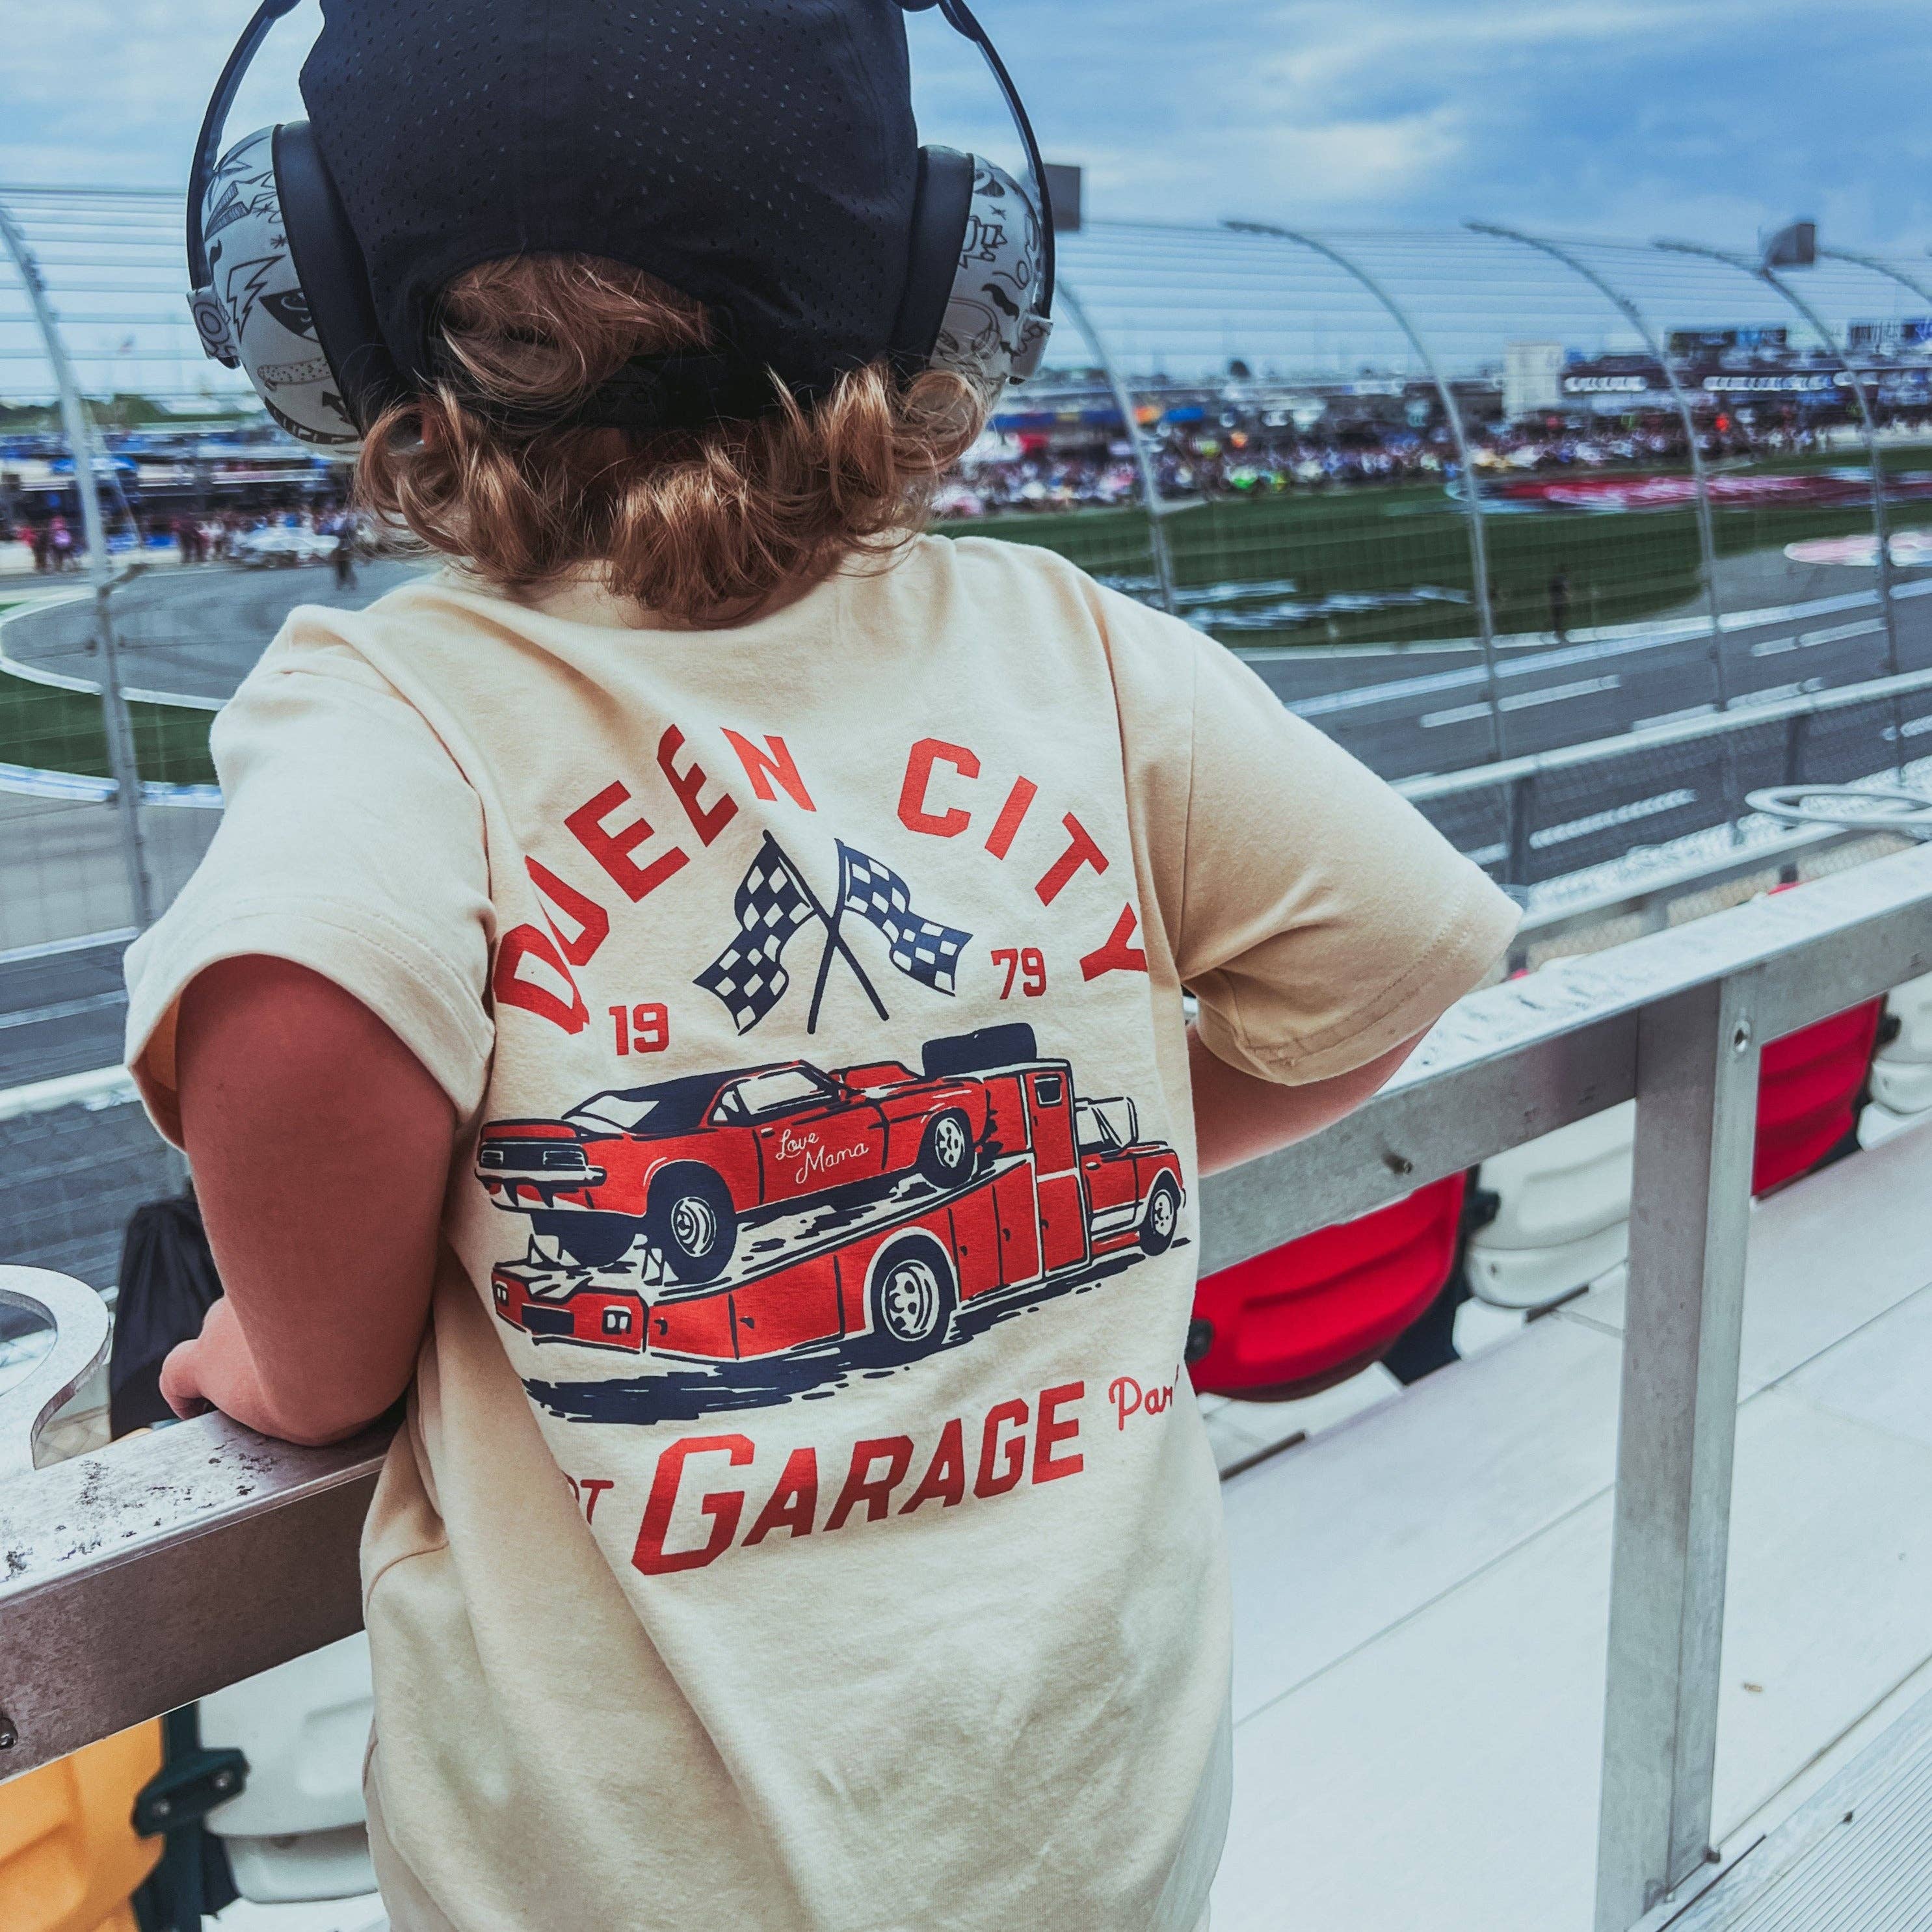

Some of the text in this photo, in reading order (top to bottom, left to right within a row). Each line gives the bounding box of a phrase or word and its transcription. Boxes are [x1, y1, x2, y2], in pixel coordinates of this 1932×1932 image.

[492, 723, 1148, 1035] QUEEN CITY
[609, 947, 1047, 1056] 19 79
[776, 1129, 819, 1160] Love
[795, 1143, 869, 1184] Mama
[1109, 1363, 1179, 1431] Par
[631, 1380, 1085, 1576] GARAGE
